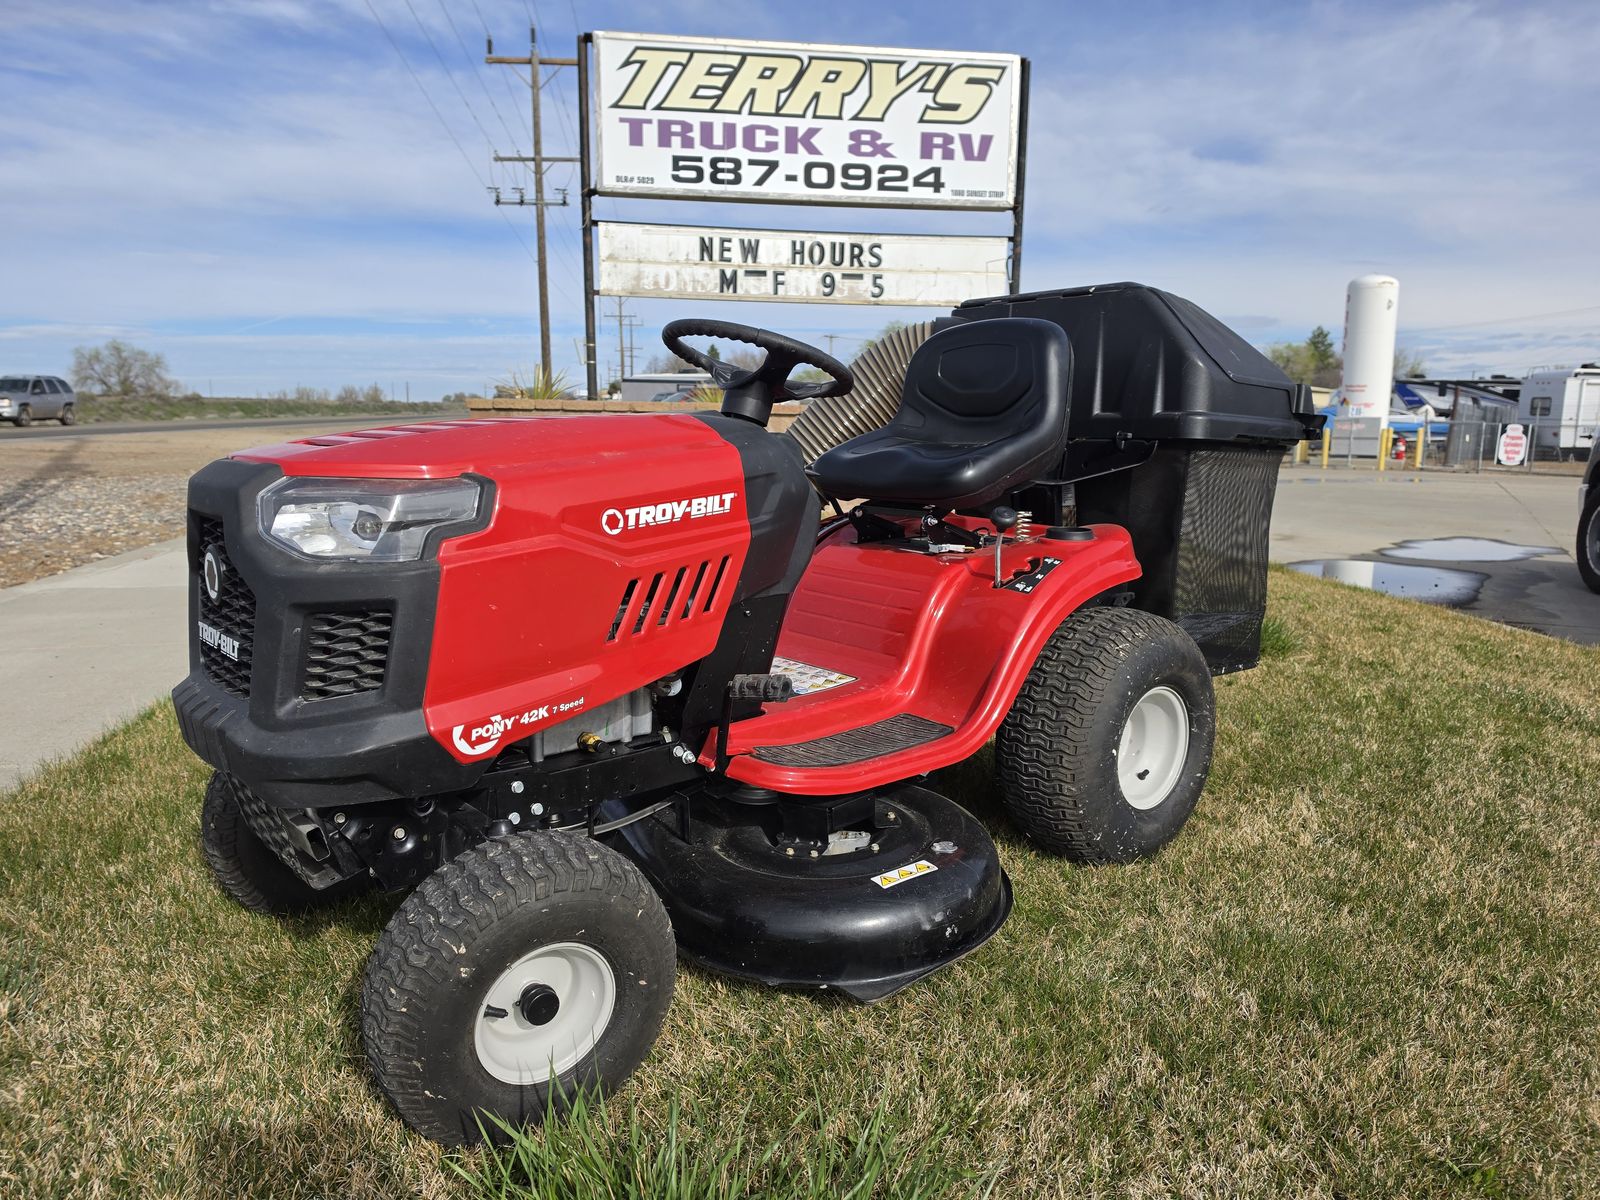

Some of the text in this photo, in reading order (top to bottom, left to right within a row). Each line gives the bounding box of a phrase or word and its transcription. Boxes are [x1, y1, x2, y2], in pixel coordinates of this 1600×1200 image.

[609, 46, 1007, 124] TERRY'S
[618, 117, 993, 162] TRUCK & RV
[671, 155, 945, 193] 587-0924
[699, 236, 883, 268] NEW HOURS
[625, 492, 736, 529] TROY-BILT
[198, 621, 240, 661] TROY-BILT
[520, 704, 549, 725] 42K
[552, 705, 558, 714] 7
[559, 697, 584, 714] Speed
